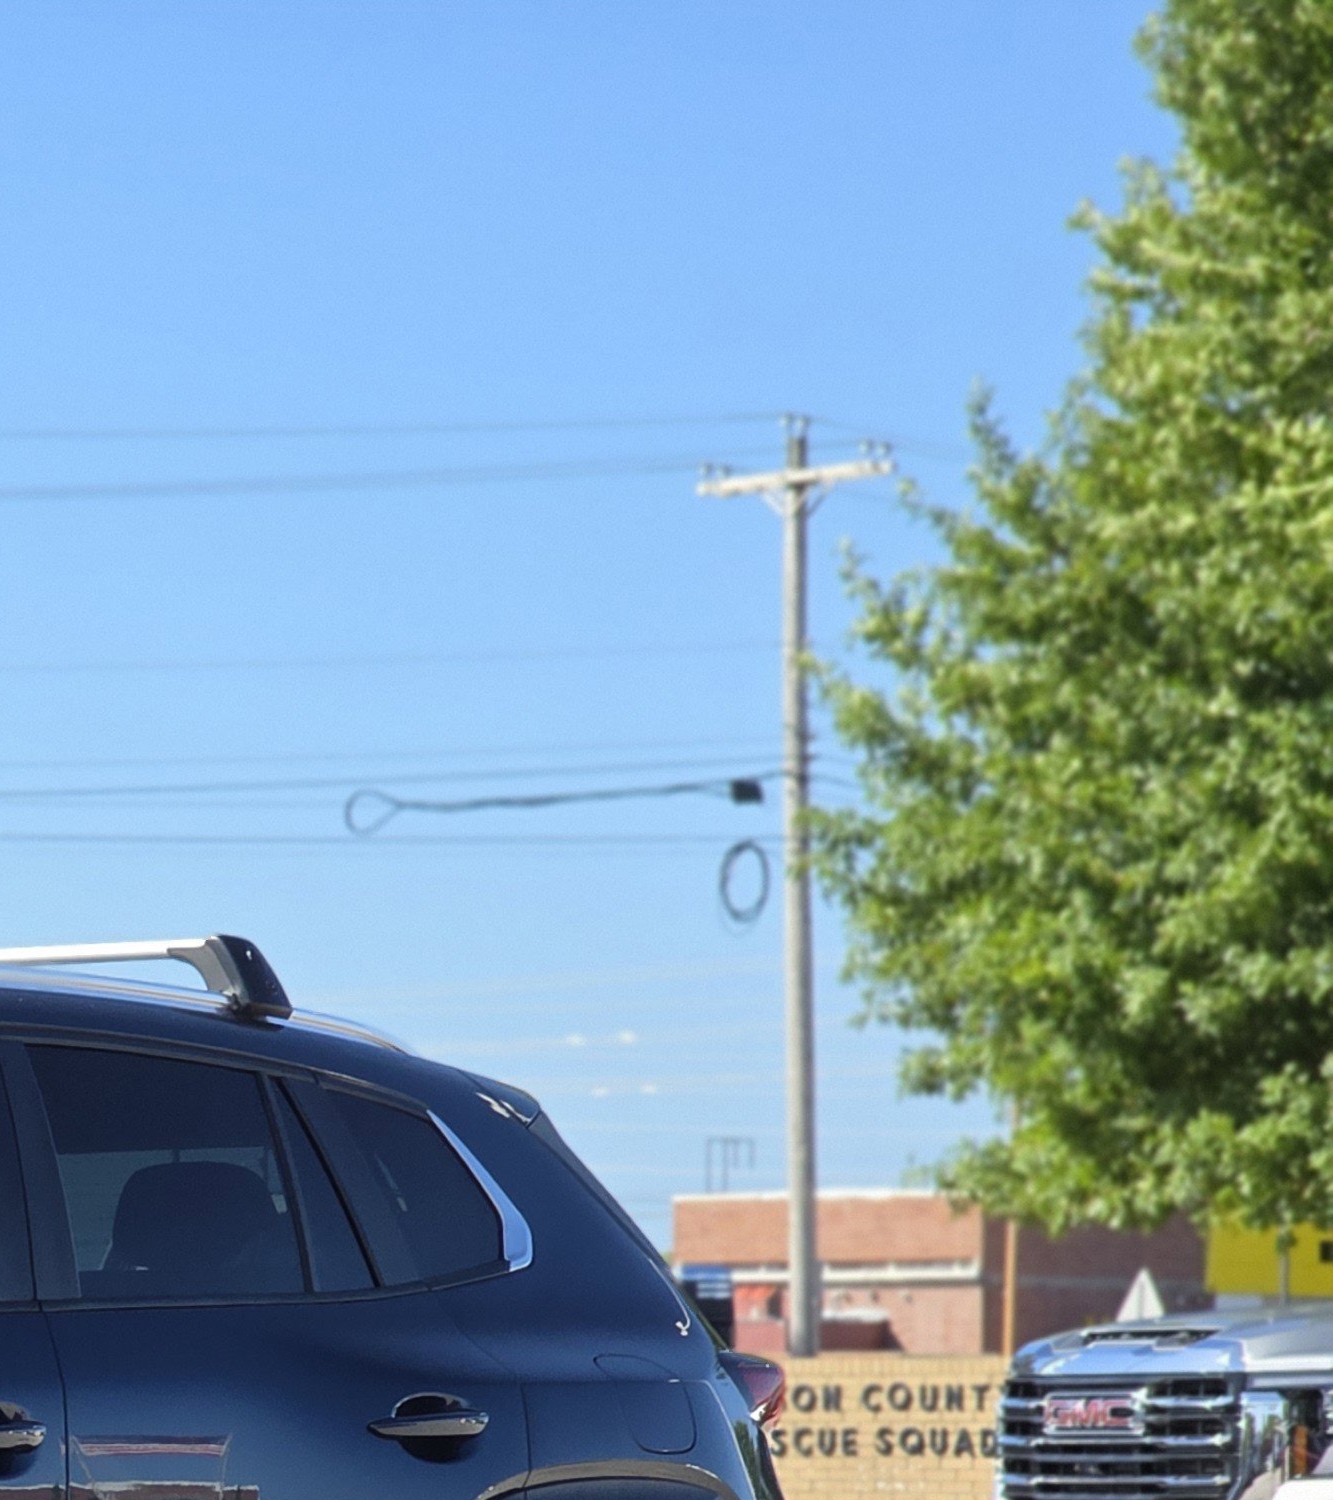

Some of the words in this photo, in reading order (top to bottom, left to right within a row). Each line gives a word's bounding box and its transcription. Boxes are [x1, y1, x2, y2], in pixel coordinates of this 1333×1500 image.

[782, 1384, 843, 1412] ON
[861, 1383, 1004, 1412] COUNT
[1046, 1398, 1135, 1428] GMC
[876, 1428, 999, 1457] SQUAD
